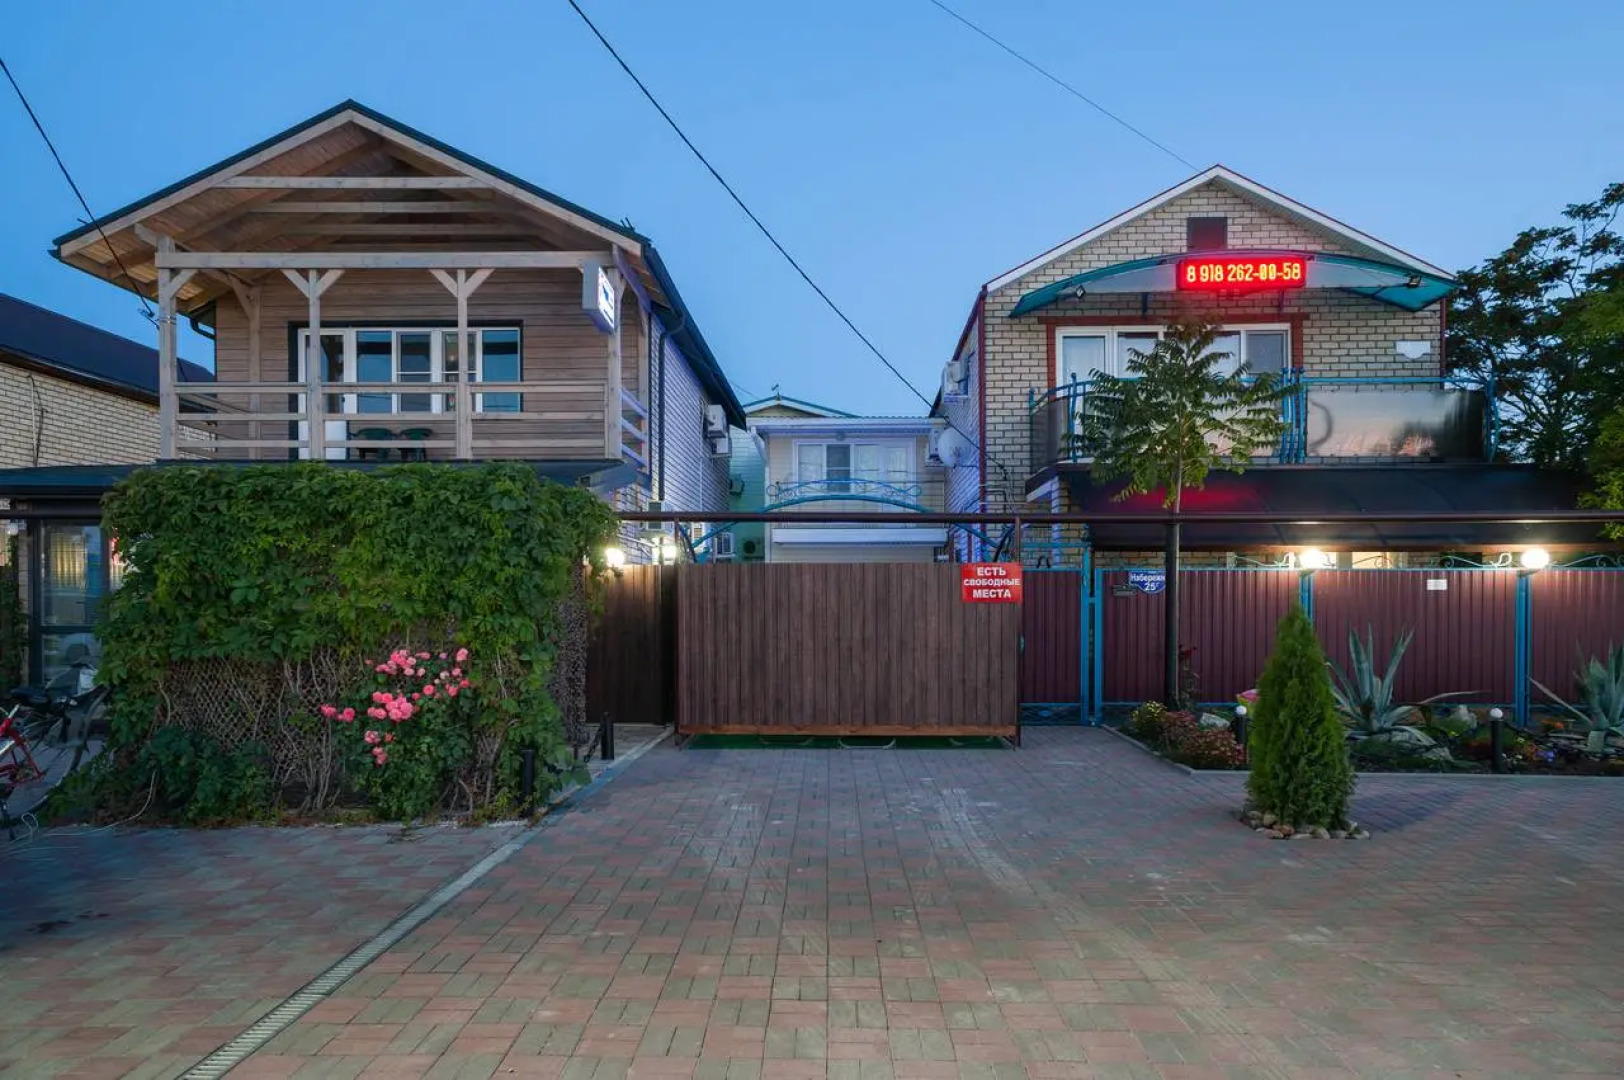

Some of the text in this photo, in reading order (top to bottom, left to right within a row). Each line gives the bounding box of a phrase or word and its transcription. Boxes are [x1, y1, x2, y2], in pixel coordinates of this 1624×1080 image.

[1187, 262, 1301, 282] 8 918 262-00-58
[977, 566, 1006, 576] ЕСТЬ
[963, 578, 1021, 587] СВОБОДНЫЕ
[1130, 573, 1166, 582] Набережн
[972, 588, 1011, 599] МЕСТА
